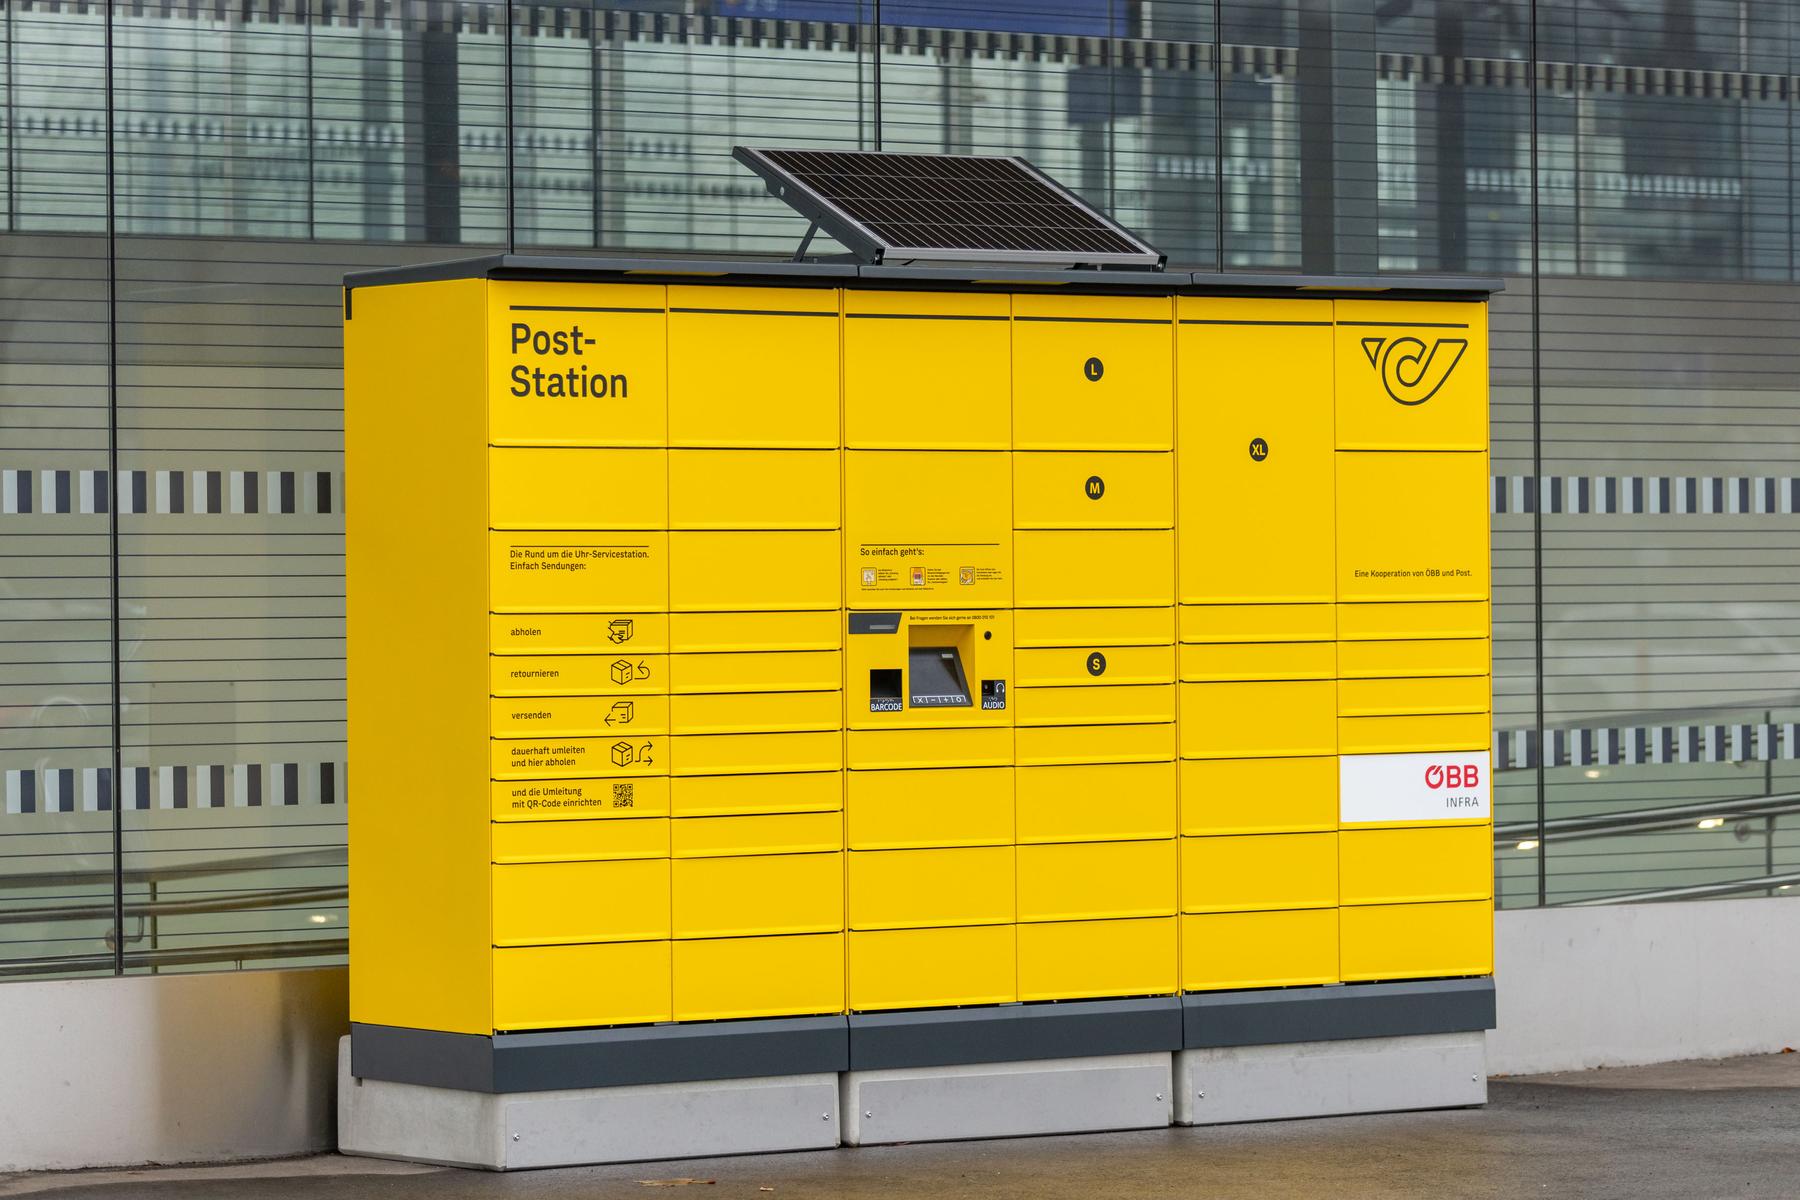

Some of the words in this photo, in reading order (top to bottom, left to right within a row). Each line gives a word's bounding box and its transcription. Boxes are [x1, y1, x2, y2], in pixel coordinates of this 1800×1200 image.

[512, 323, 595, 355] Post-
[1091, 363, 1098, 375] L
[511, 365, 627, 398] Station
[1252, 444, 1266, 456] XL
[1089, 482, 1100, 494] M
[511, 549, 522, 558] Die
[525, 549, 544, 558] Rund
[547, 551, 559, 559] um
[561, 549, 573, 558] die
[575, 549, 649, 558] Uhr-Servicestation.
[861, 547, 869, 556] So
[872, 547, 898, 556] einfach
[900, 547, 924, 557] geht's:
[511, 561, 539, 570] Einfach
[542, 561, 586, 571] Sendungen:
[1355, 569, 1369, 578] Eine
[1371, 569, 1410, 578] Kooperation
[1426, 569, 1440, 577] ÖBB
[1442, 569, 1454, 577] und
[1456, 568, 1472, 577] Post.
[511, 627, 541, 636] abholen
[1092, 658, 1101, 670] S
[511, 669, 559, 678] retournieren
[871, 702, 902, 711] BARCODE
[983, 701, 1004, 709] AUDIO
[512, 711, 551, 720] versenden
[512, 746, 549, 755] dauerhaft
[552, 745, 585, 754] umleiten
[512, 758, 526, 767] und
[529, 758, 543, 767] hier
[546, 758, 575, 767] abholen
[1425, 765, 1478, 789] ÖBB
[512, 788, 526, 797] und
[529, 787, 540, 796] die
[543, 786, 582, 796] Umleitung
[512, 799, 524, 808] mit
[527, 799, 561, 809] QR-Code
[563, 798, 601, 807] einrichten
[1447, 797, 1478, 807] INFRA
